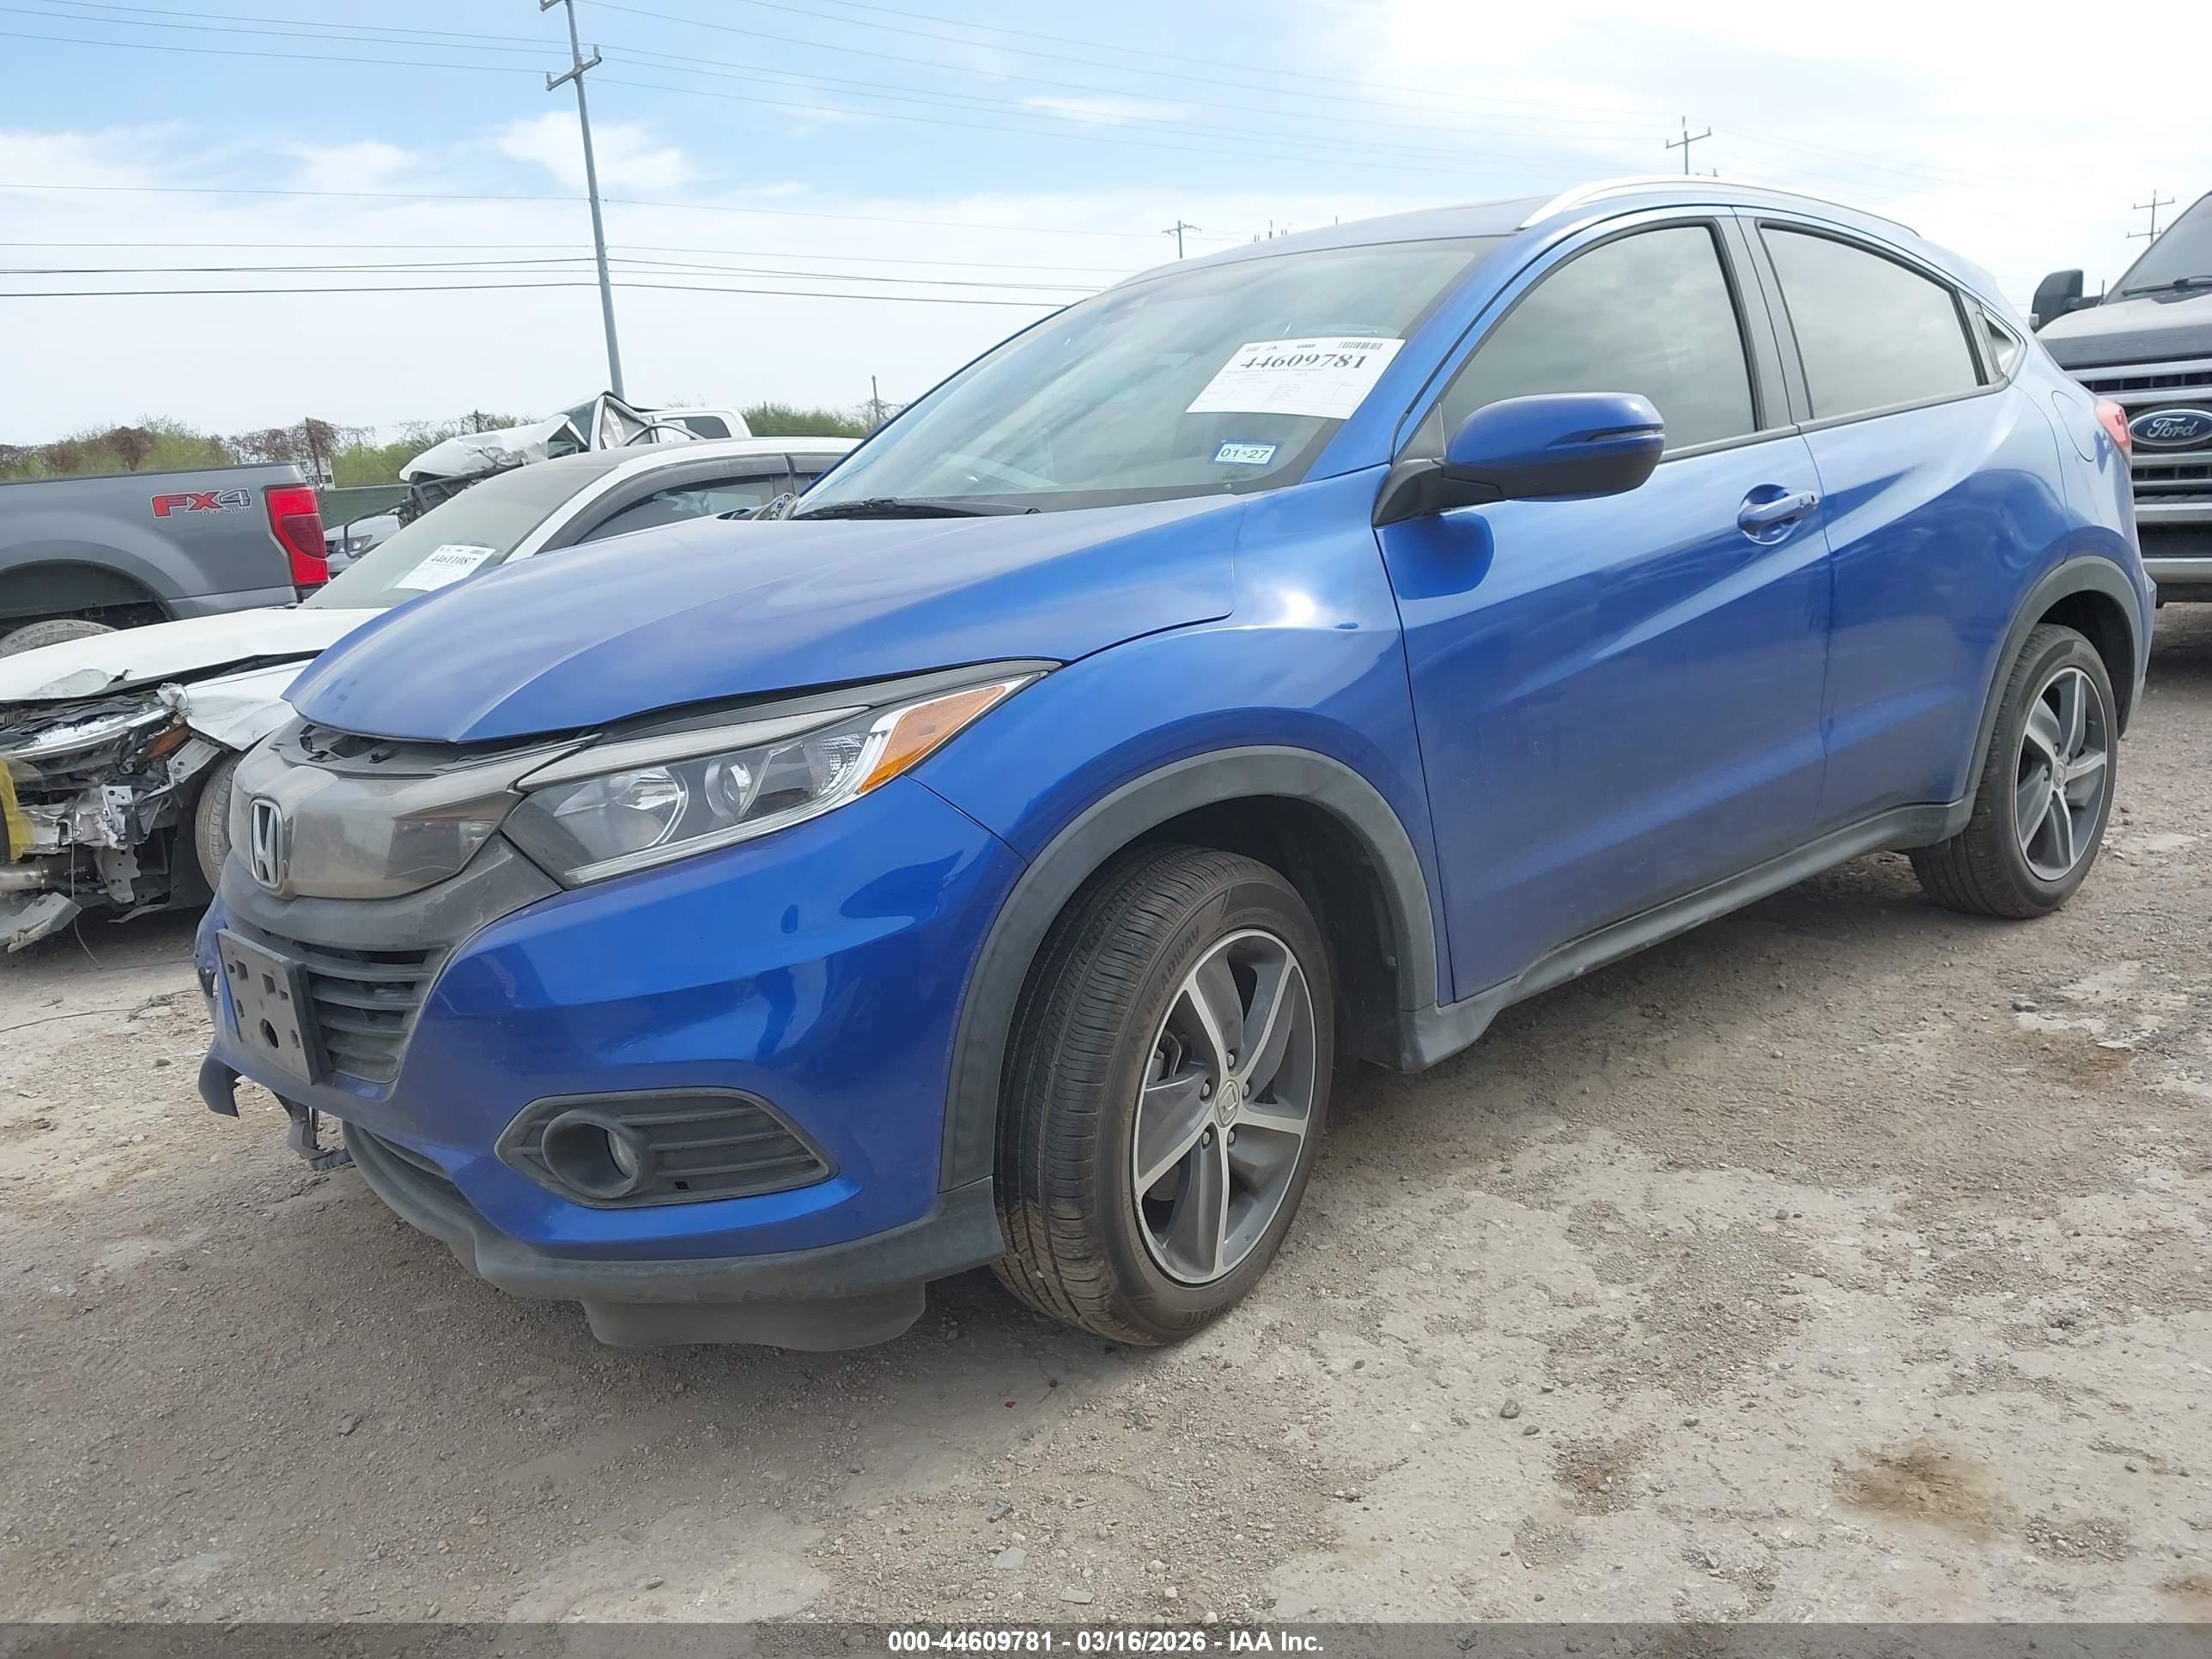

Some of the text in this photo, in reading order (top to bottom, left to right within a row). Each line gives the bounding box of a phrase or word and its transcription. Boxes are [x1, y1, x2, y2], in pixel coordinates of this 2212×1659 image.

[1240, 352, 1368, 369] 44609781
[2147, 417, 2198, 438] Ford
[150, 488, 252, 518] FX4
